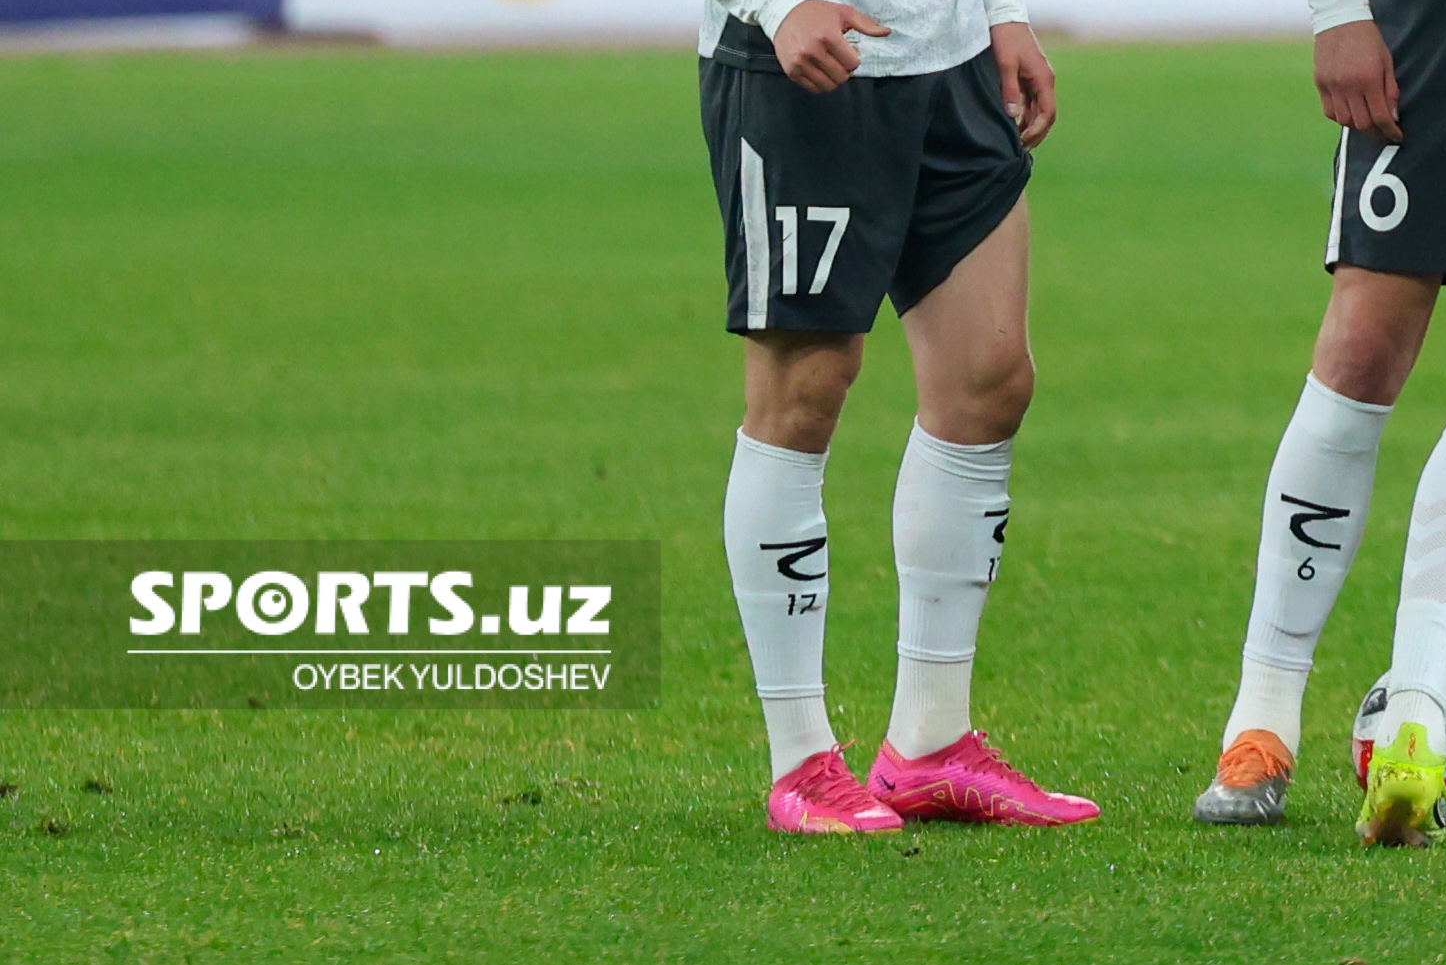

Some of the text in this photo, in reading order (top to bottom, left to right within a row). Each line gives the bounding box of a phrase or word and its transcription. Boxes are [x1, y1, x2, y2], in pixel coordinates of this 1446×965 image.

[1359, 145, 1409, 232] 6
[775, 206, 850, 295] 17
[1297, 557, 1315, 581] 6
[788, 593, 817, 616] 17
